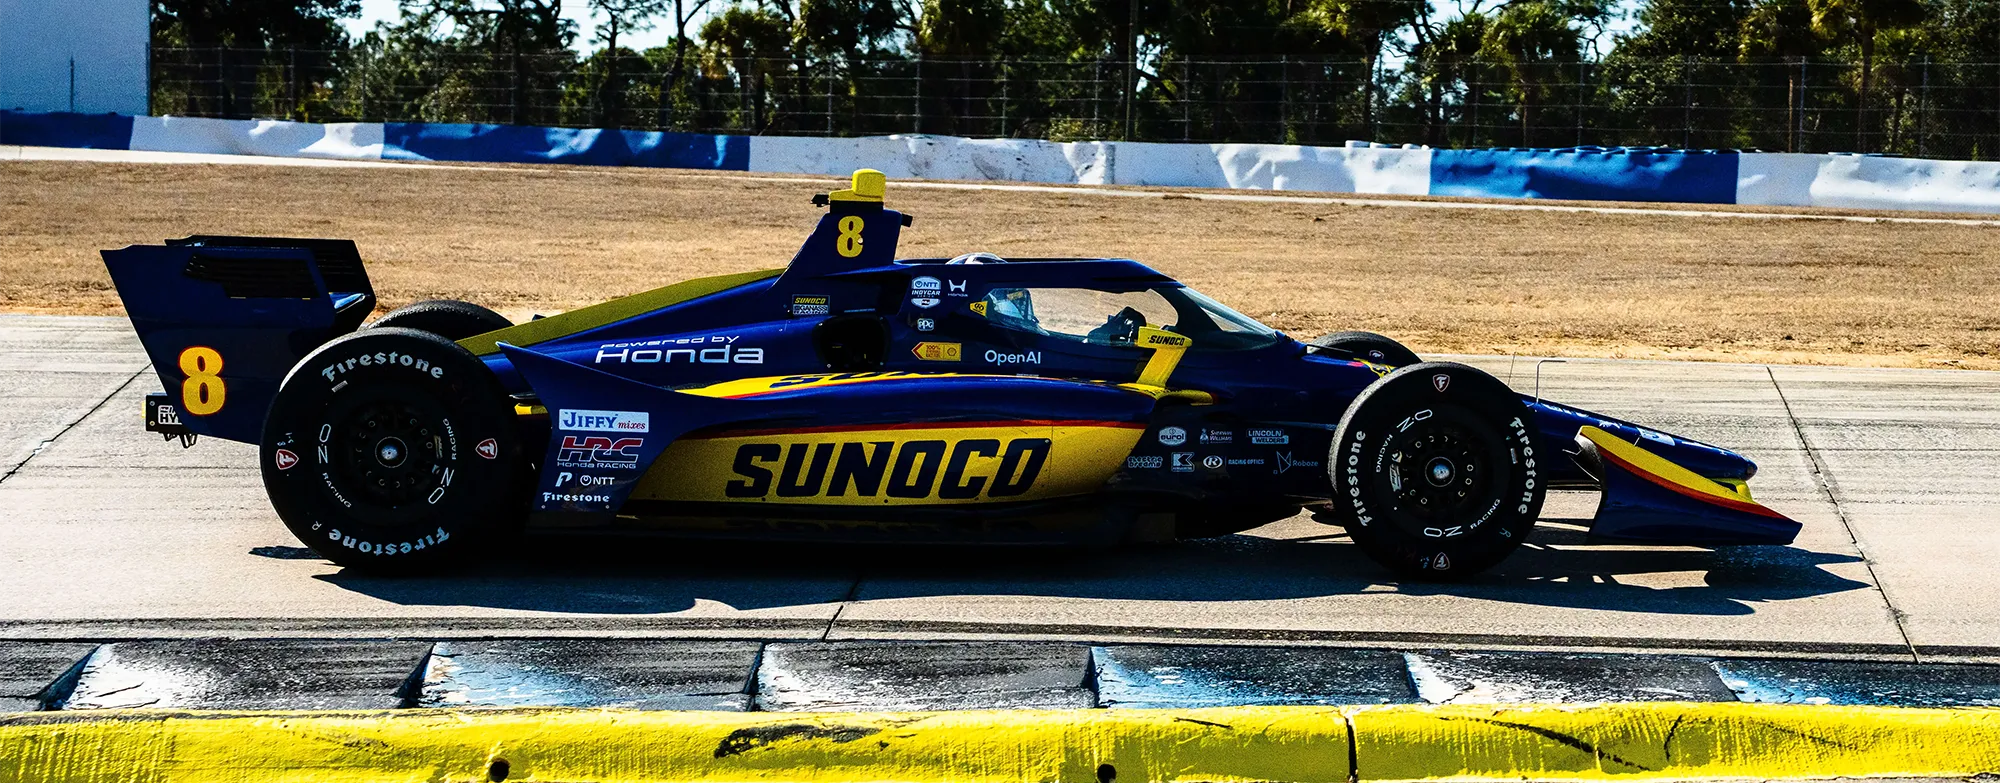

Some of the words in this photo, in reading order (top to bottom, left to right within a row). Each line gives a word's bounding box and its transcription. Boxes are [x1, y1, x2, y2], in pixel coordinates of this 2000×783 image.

[837, 215, 865, 258] 8
[594, 344, 764, 364] Honda
[600, 337, 705, 348] powered
[711, 335, 740, 344] by
[1148, 334, 1186, 346] SUNOCO
[321, 351, 444, 382] Firestone
[984, 350, 1042, 366] OpenAI
[178, 345, 228, 417] 8
[442, 418, 457, 461] RACING
[617, 420, 646, 430] mixes
[1160, 433, 1185, 441] eurol
[557, 435, 644, 463] HRC
[725, 438, 1052, 499] SUNOCO
[1347, 430, 1373, 527] Firestone
[1509, 416, 1537, 515] Firestone
[592, 476, 616, 485] NTT
[542, 491, 610, 502] Firestone
[1469, 498, 1501, 530] RACING
[328, 526, 450, 556] Firestone
